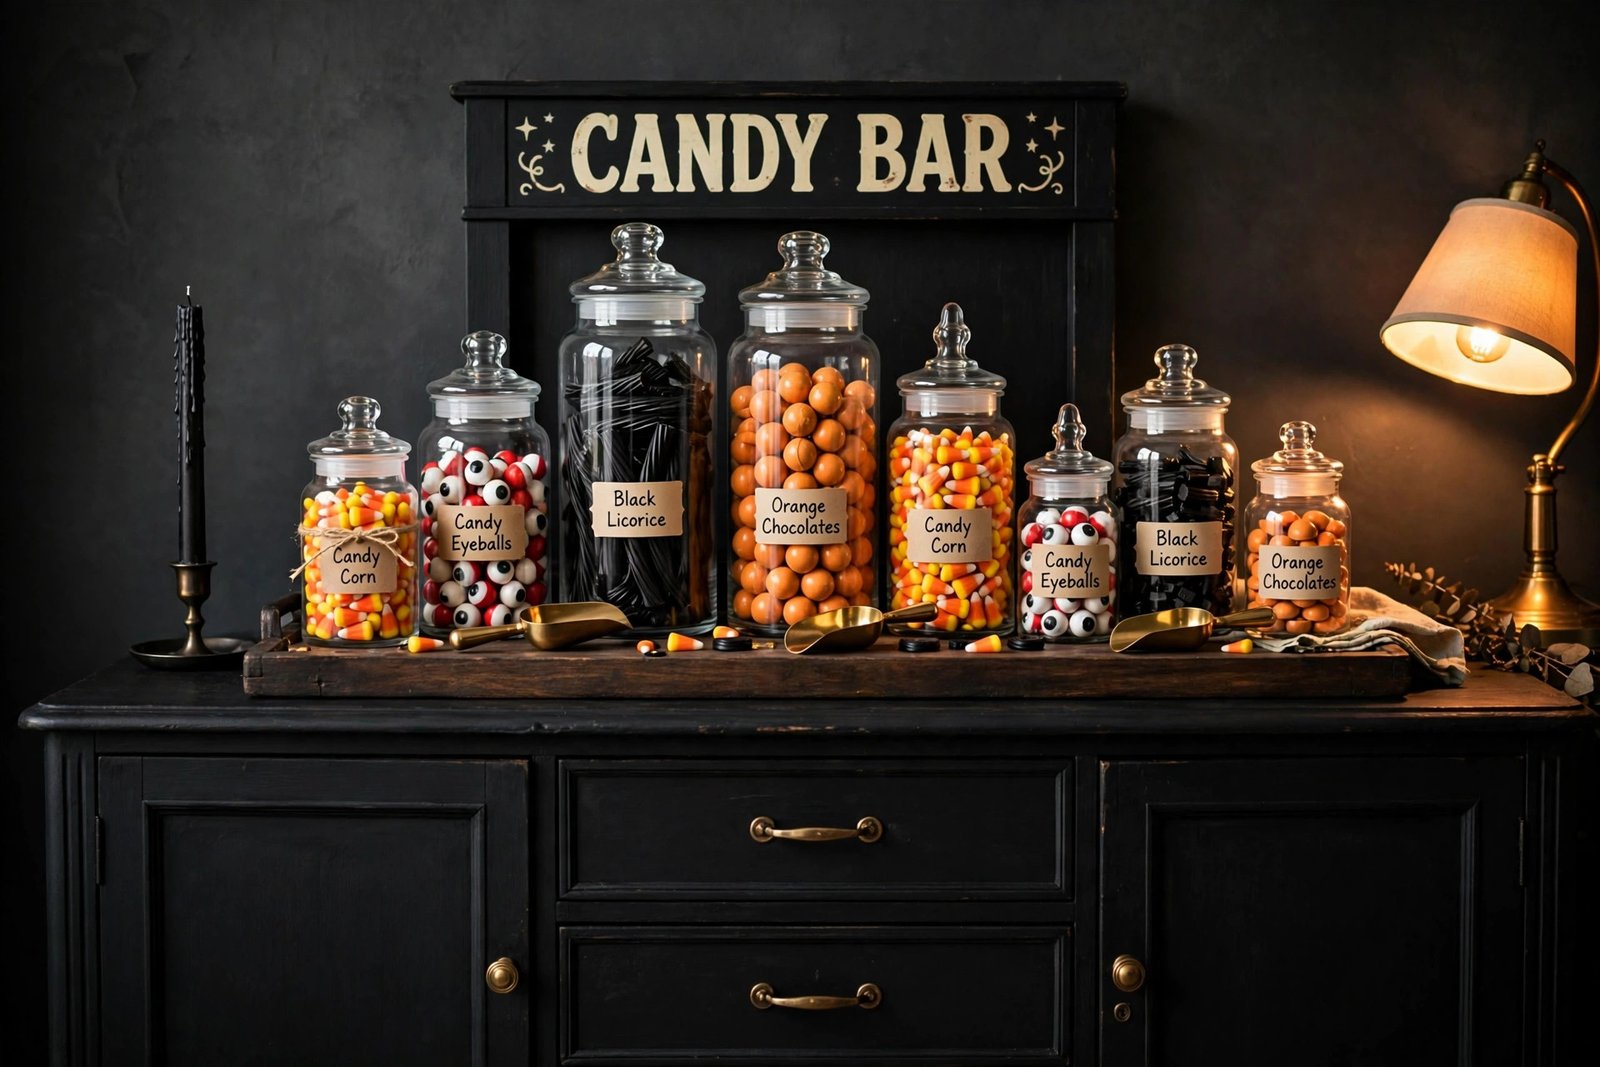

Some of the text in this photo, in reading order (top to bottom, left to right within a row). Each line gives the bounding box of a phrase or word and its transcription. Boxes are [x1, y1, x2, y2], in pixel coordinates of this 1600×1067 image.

[571, 113, 1012, 193] CANDY BAR
[614, 490, 656, 507] Black
[772, 496, 825, 519] Orange
[455, 513, 502, 539] Candy
[608, 511, 666, 528] Licorice
[762, 518, 840, 535] Chocolates
[925, 516, 971, 538] Candy
[451, 534, 512, 557] Eyeballs
[931, 537, 966, 553] Corn
[1157, 529, 1198, 546] Black
[333, 546, 381, 568] Candy
[1045, 550, 1092, 574] Candy
[1150, 550, 1207, 567] Licorice
[1271, 553, 1323, 575] Orange
[340, 568, 376, 584] Corn
[1041, 571, 1100, 593] Eyeballs
[1263, 573, 1336, 590] Chocolates
